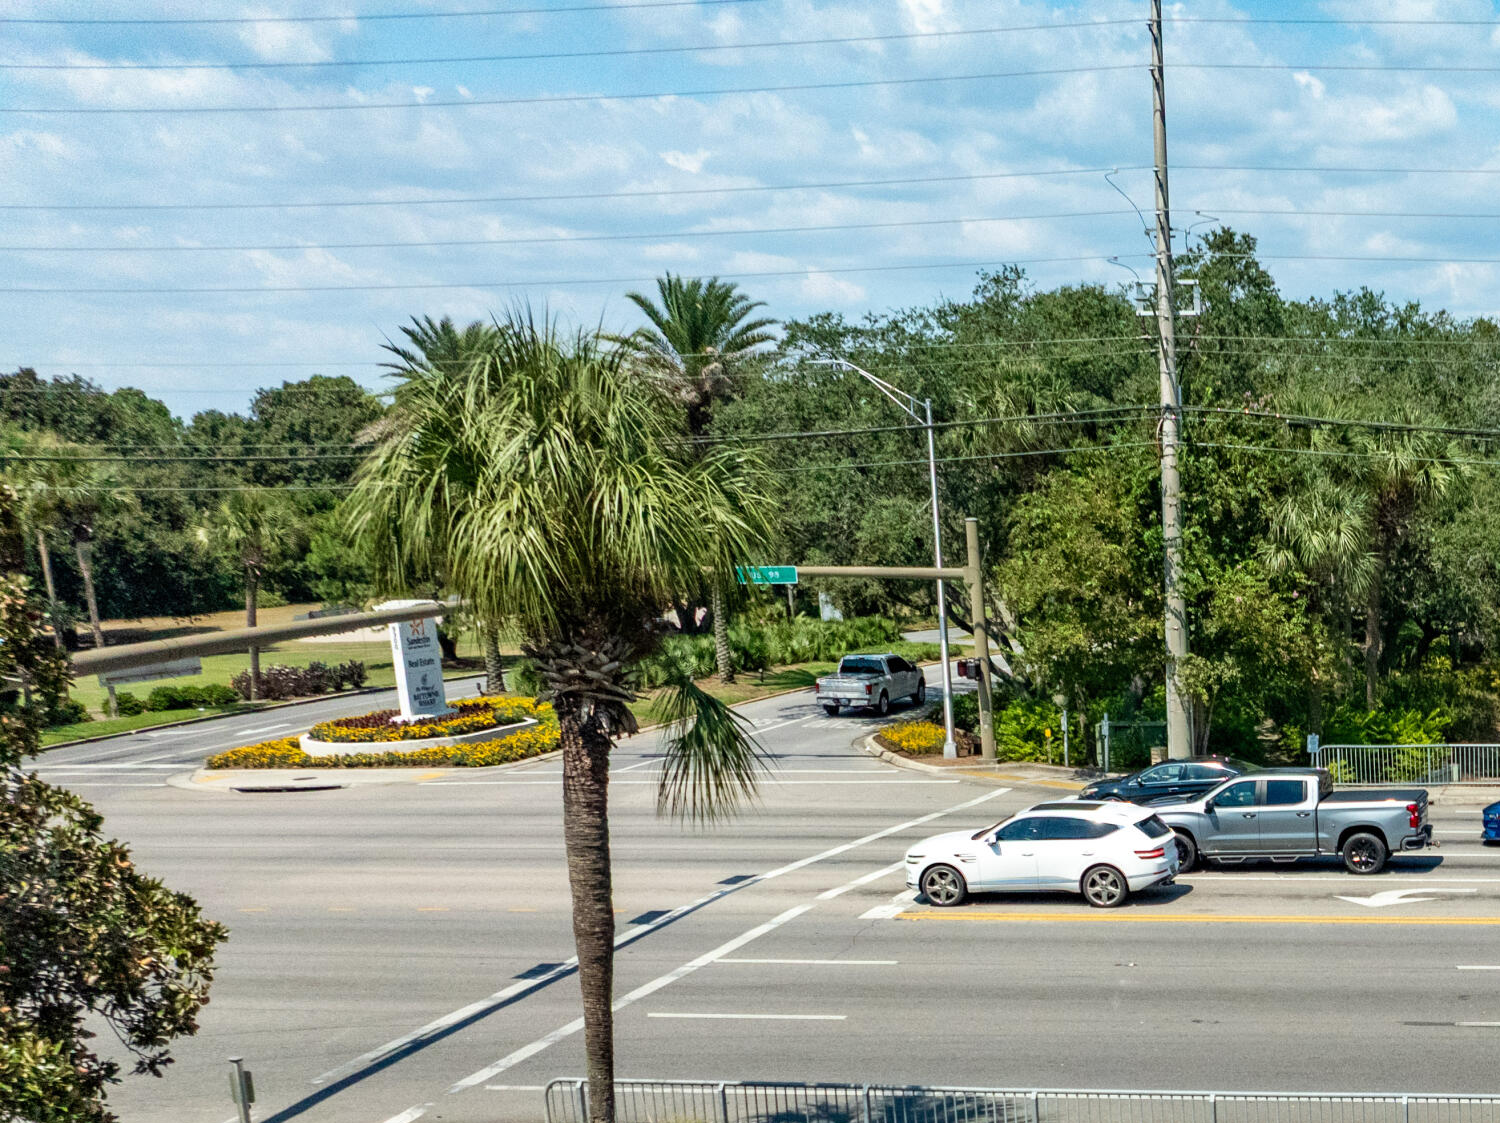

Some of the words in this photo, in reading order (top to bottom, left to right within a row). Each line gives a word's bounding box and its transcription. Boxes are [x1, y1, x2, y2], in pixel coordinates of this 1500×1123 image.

[406, 636, 431, 646] Sandestin
[408, 659, 419, 668] Real
[419, 658, 435, 667] Estate
